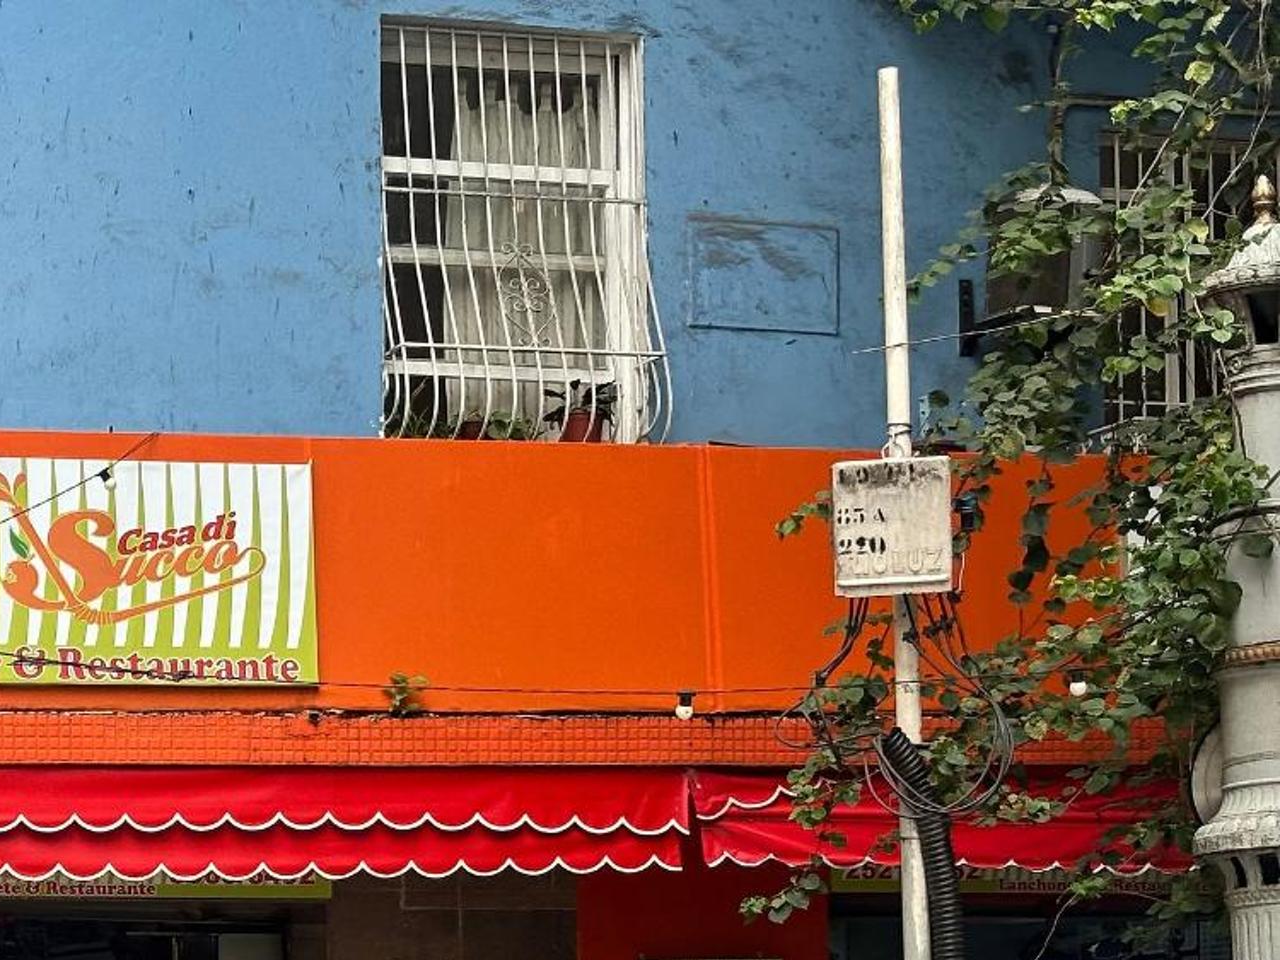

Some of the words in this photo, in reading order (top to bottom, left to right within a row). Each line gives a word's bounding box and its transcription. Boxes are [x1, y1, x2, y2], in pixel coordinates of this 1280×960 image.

[117, 525, 198, 556] Casa
[201, 511, 237, 546] di
[47, 508, 244, 603] Succo
[13, 646, 46, 681] &
[59, 647, 300, 682] Restaurante
[25, 880, 39, 895] &
[45, 880, 156, 896] Restaurante
